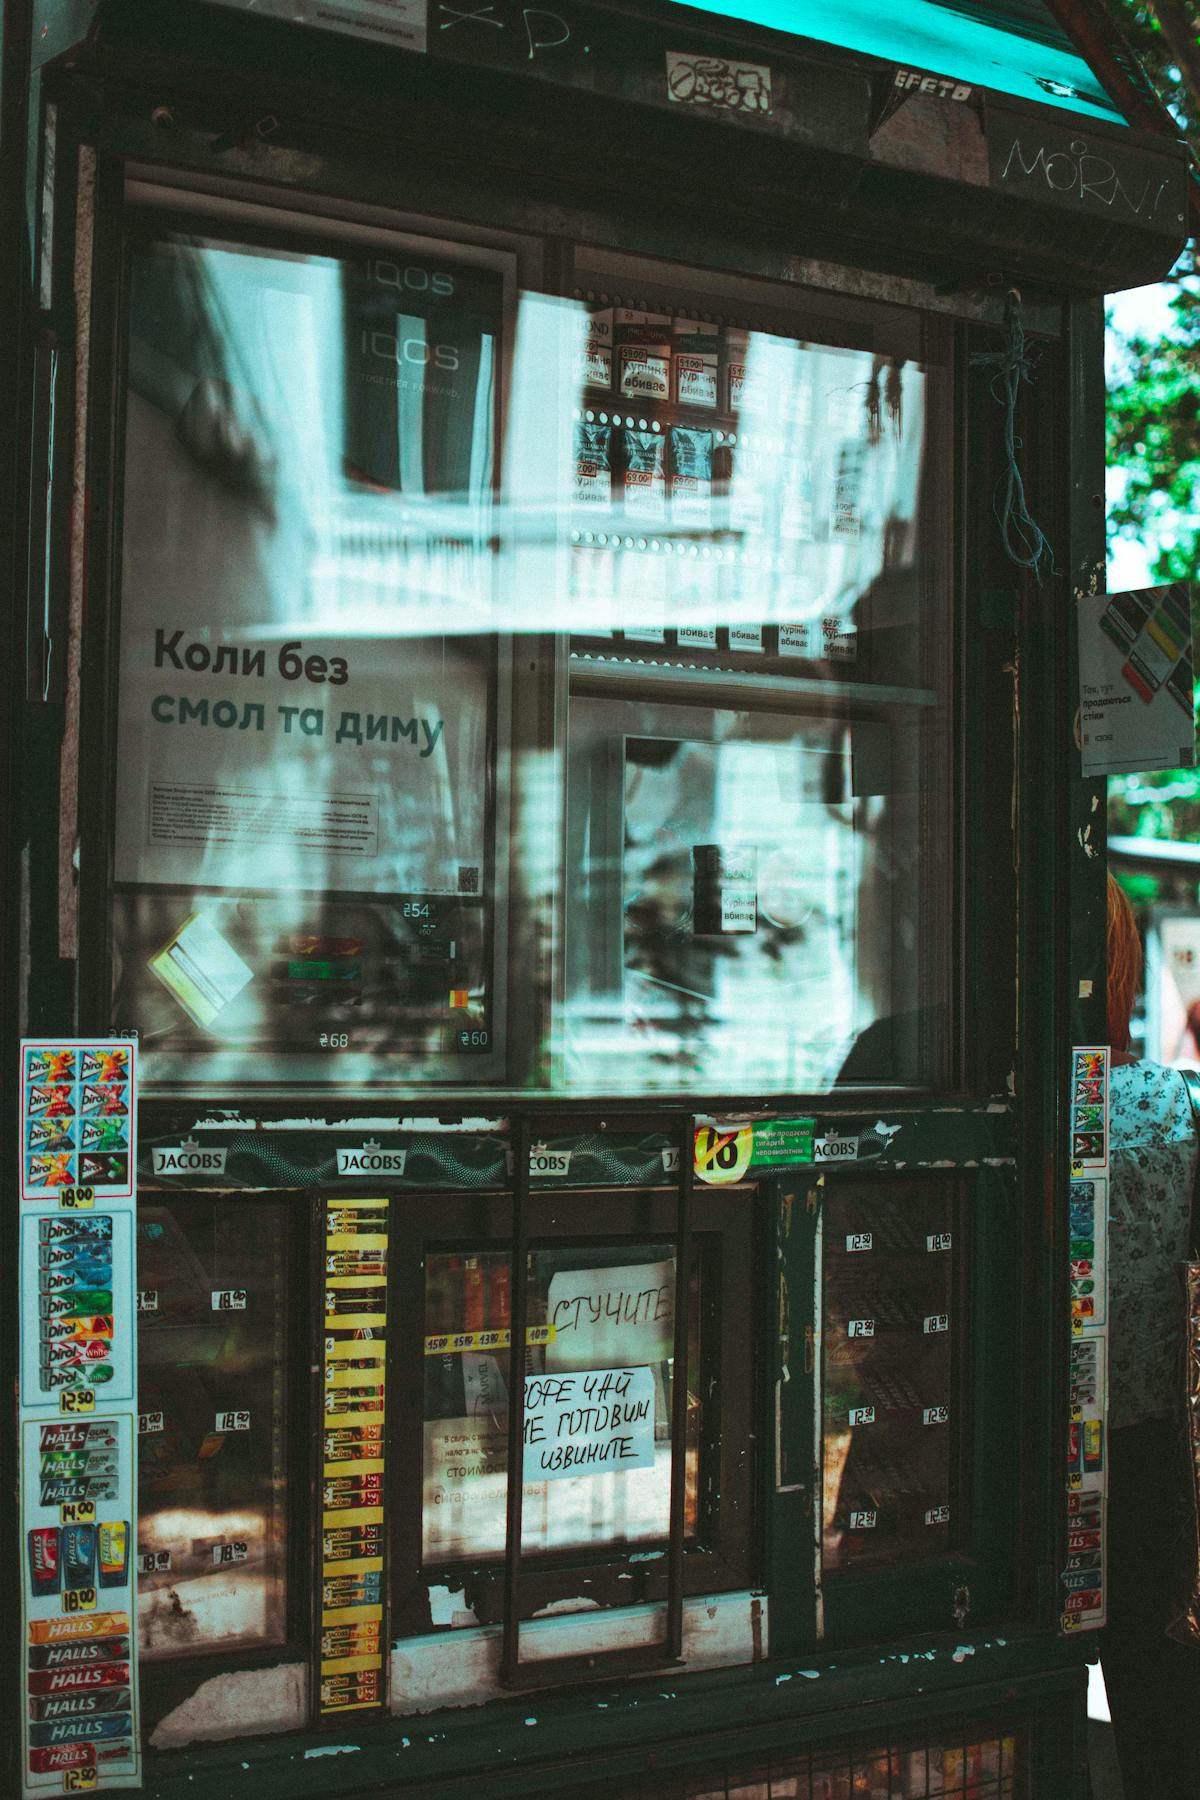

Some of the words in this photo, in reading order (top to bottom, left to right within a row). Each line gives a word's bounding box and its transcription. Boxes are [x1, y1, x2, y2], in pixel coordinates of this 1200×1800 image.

[366, 259, 455, 296] IQOS
[585, 319, 609, 336] OND
[361, 330, 460, 371] IQOS
[624, 375, 666, 393] вбиває
[154, 628, 266, 678] Коли
[278, 641, 349, 686] без
[150, 694, 266, 732] смол
[277, 705, 325, 737] та
[335, 710, 444, 758] диму
[29, 1060, 51, 1072] Dirol
[81, 1060, 104, 1072] Dirol
[29, 1094, 52, 1106] Dirol
[82, 1092, 105, 1104] Dirol
[29, 1128, 52, 1140] Dirol
[82, 1127, 105, 1139] Dirol
[706, 1127, 739, 1170] 18
[814, 1141, 856, 1157] ACOBS
[29, 1163, 51, 1175] Dirol
[157, 1153, 222, 1171] JACOBS
[341, 1153, 402, 1171] JACOBS
[528, 1155, 567, 1171] COBS
[48, 1225, 77, 1239] Dirol
[48, 1249, 76, 1264] Dirol
[48, 1274, 76, 1288] Dirol
[48, 1299, 76, 1314] Dirol
[552, 1285, 672, 1332] СТУЧИТЕ
[48, 1323, 76, 1338] Dirol
[49, 1347, 77, 1361] Dirol
[49, 1371, 77, 1385] Dirol
[479, 1360, 490, 1405] MARVEL
[557, 1400, 650, 1437] ГОТОВИМ
[45, 1430, 86, 1445] HALLS
[540, 1437, 639, 1471] ИЗВИНИТЕ
[45, 1458, 86, 1473] HALLS
[45, 1485, 86, 1500] HALLS
[34, 1535, 42, 1569] HALLS
[68, 1531, 78, 1566] HALLS
[102, 1528, 112, 1563] HALLS
[49, 1620, 93, 1637] HALLS
[47, 1645, 98, 1666] HALLS
[51, 1670, 101, 1690] HALLS
[44, 1697, 96, 1718] HALLS
[51, 1721, 103, 1741] HALLS
[50, 1750, 88, 1765] HALLS
